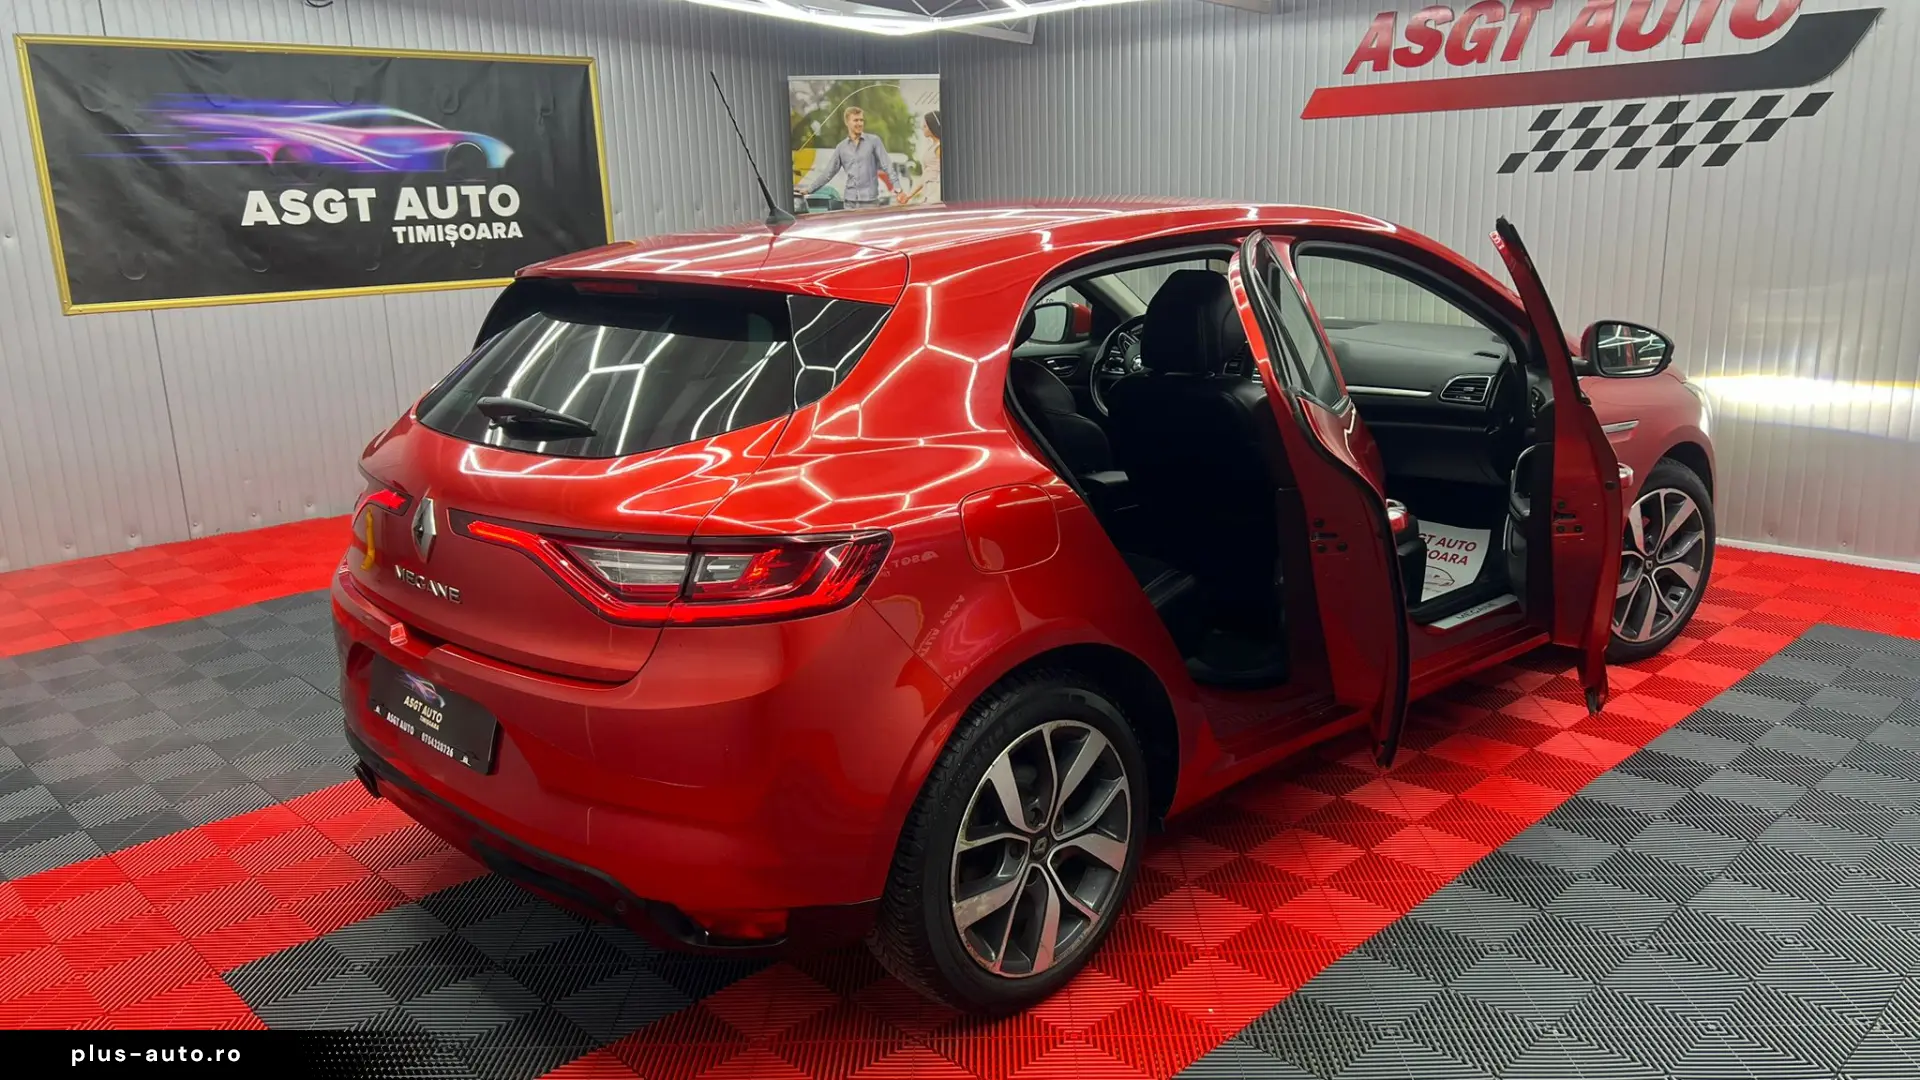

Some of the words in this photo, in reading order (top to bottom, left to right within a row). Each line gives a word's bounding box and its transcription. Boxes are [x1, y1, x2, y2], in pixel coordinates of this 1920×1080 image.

[1342, 0, 1554, 75] ASGT
[1550, 0, 1799, 57] AUTO
[241, 188, 376, 226] ASGT
[394, 184, 521, 221] AUTO
[392, 222, 523, 248] TIMIȘOARA
[1427, 549, 1468, 566] OARA
[1435, 537, 1477, 552] AUTO
[395, 564, 462, 604] MEGANE
[403, 695, 422, 712] ASGT
[421, 705, 443, 724] AUTO
[386, 711, 399, 727] ASGT
[399, 719, 415, 736] AUTO
